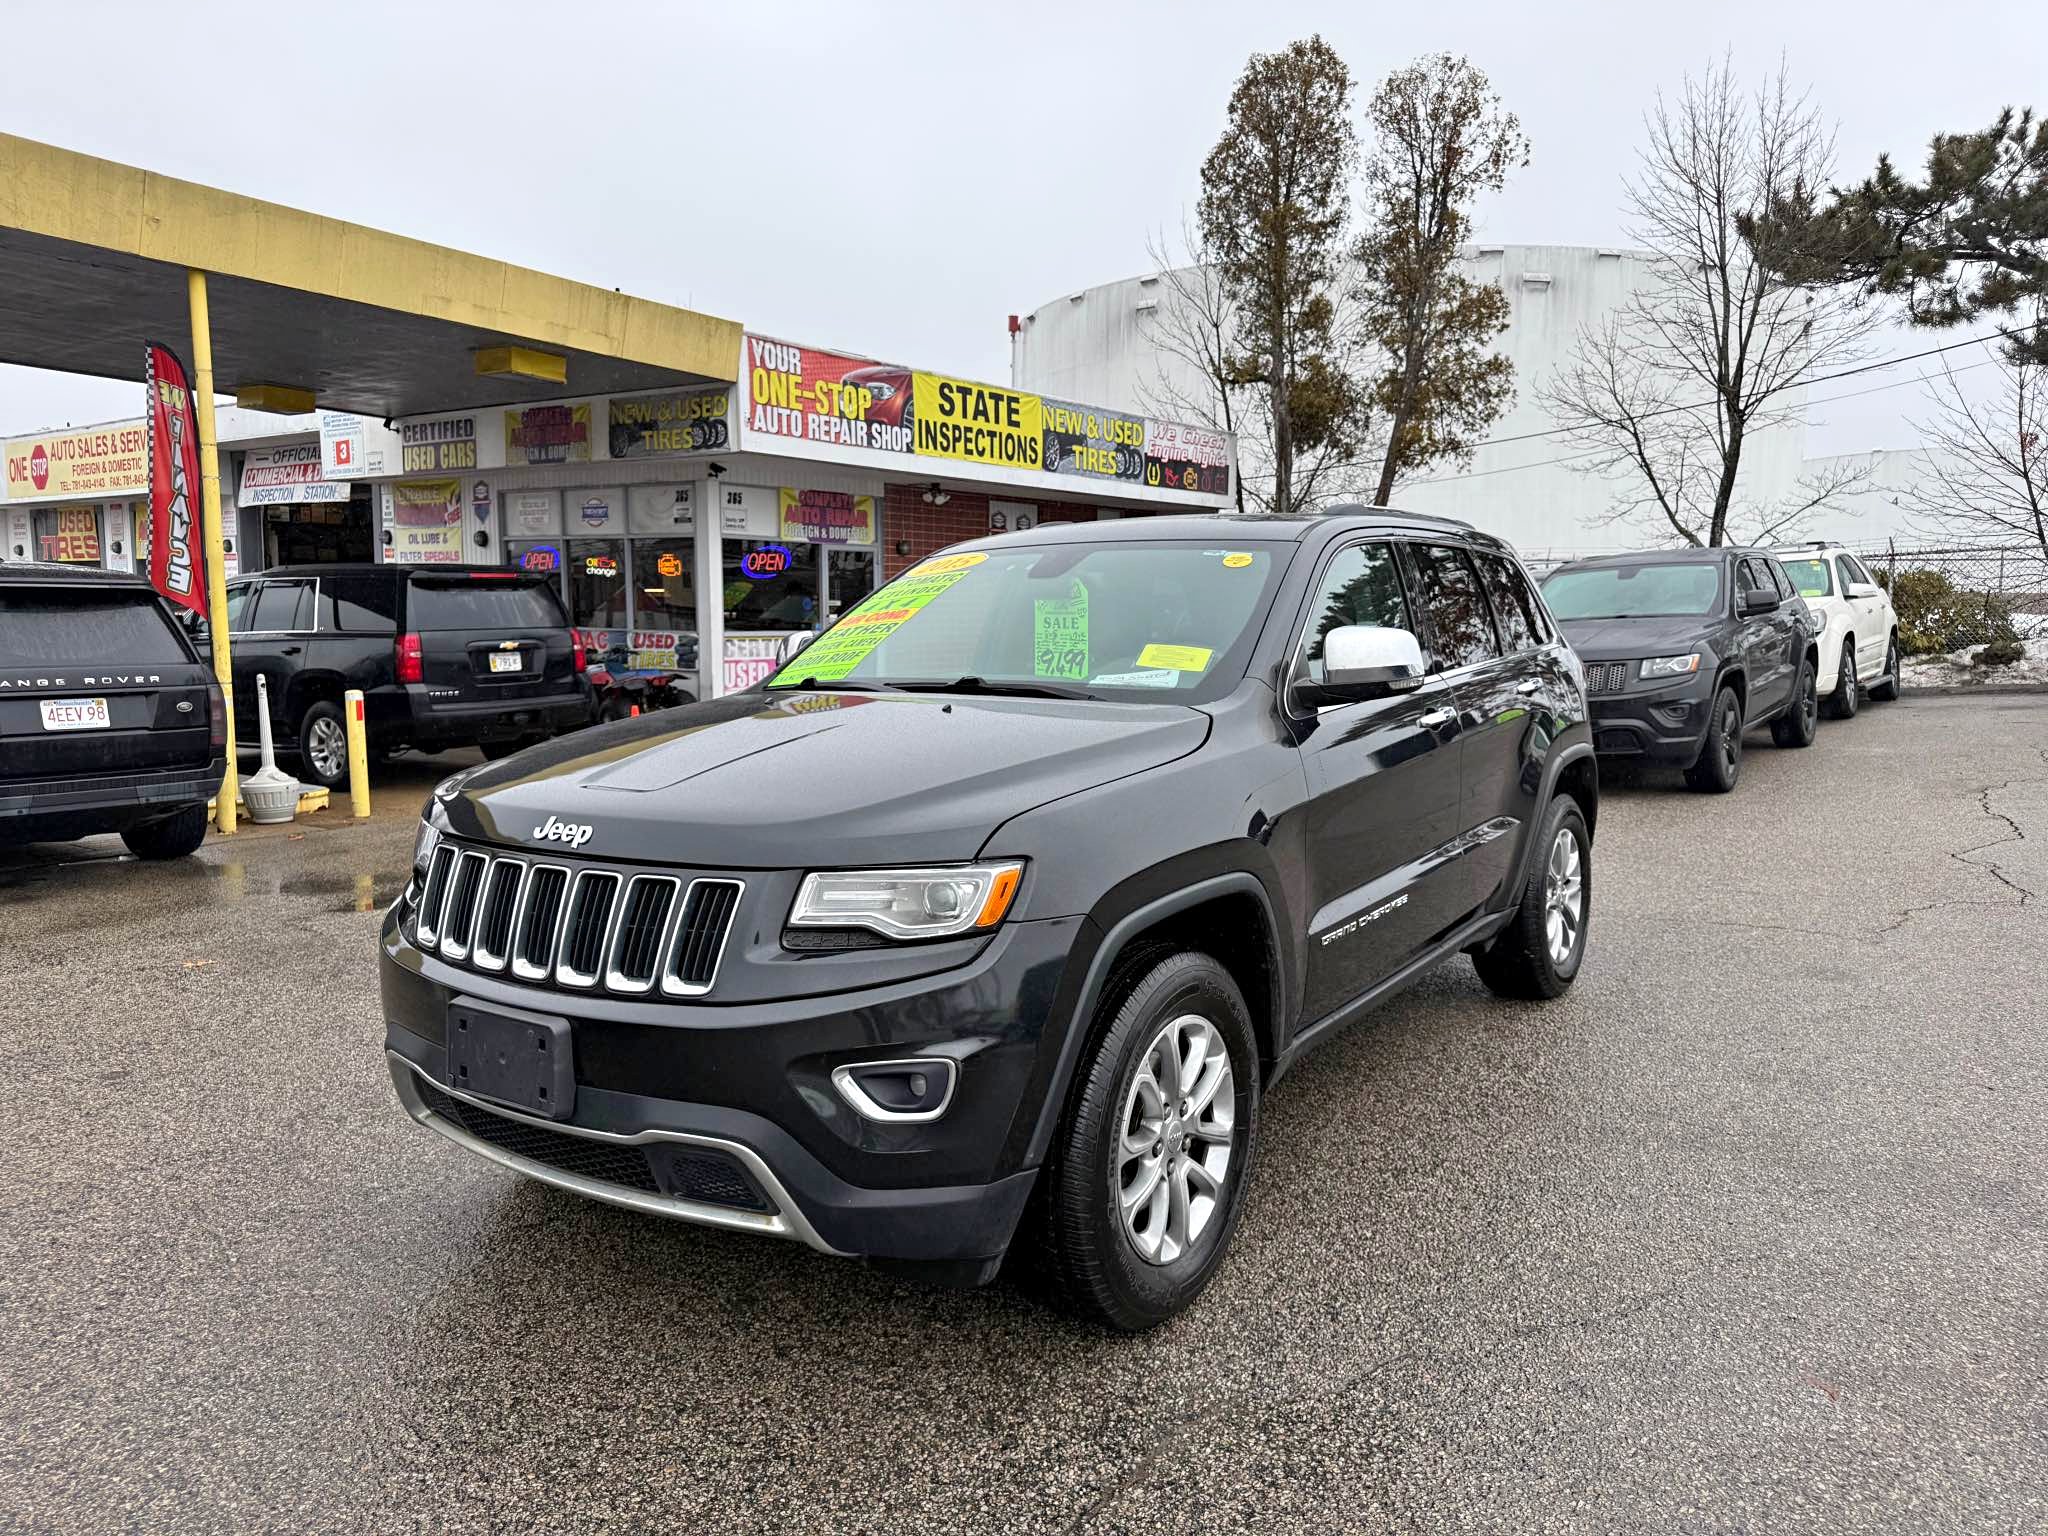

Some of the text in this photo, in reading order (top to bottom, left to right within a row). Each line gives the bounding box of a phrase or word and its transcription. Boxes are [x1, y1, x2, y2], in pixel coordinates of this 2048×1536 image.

[752, 338, 801, 375] YOUR
[753, 367, 872, 420] ONE-STOP
[939, 382, 1020, 428] STATE
[612, 396, 728, 425] NEW & USED
[403, 418, 474, 443] CERTIFIED
[641, 427, 692, 450] TIRES
[754, 405, 911, 452] AUTO REPAIR SHOP
[1043, 406, 1144, 447] NEW & USED
[1153, 421, 1226, 450] We Check
[50, 439, 76, 461] AUTO
[78, 435, 108, 459] SALES
[111, 433, 118, 454] &
[918, 418, 1038, 465] INSPECTIONS
[72, 457, 142, 477] FOREIGN & DOMESTIC
[404, 446, 434, 471] USED
[440, 441, 475, 469] CARS
[1072, 444, 1118, 475] TIRES
[1147, 440, 1227, 469] Engine Lights
[9, 456, 48, 483] ONE STOP
[246, 464, 304, 487] COMMERCIAL
[305, 464, 313, 481] &
[253, 485, 337, 503] INSPECTION STATION
[59, 509, 94, 532] USED
[40, 535, 99, 560] TIRES
[408, 534, 420, 545] OIL
[421, 533, 440, 544] LUBE
[525, 552, 554, 570] OPEN
[586, 567, 616, 577] change
[748, 553, 784, 571] OPEN
[1043, 617, 1079, 630] SALE
[634, 634, 675, 650] USED
[84, 675, 160, 685] ROVER
[48, 706, 105, 723] 4EEV 98
[533, 815, 593, 849] Jeep
[1321, 920, 1357, 946] GRAND
